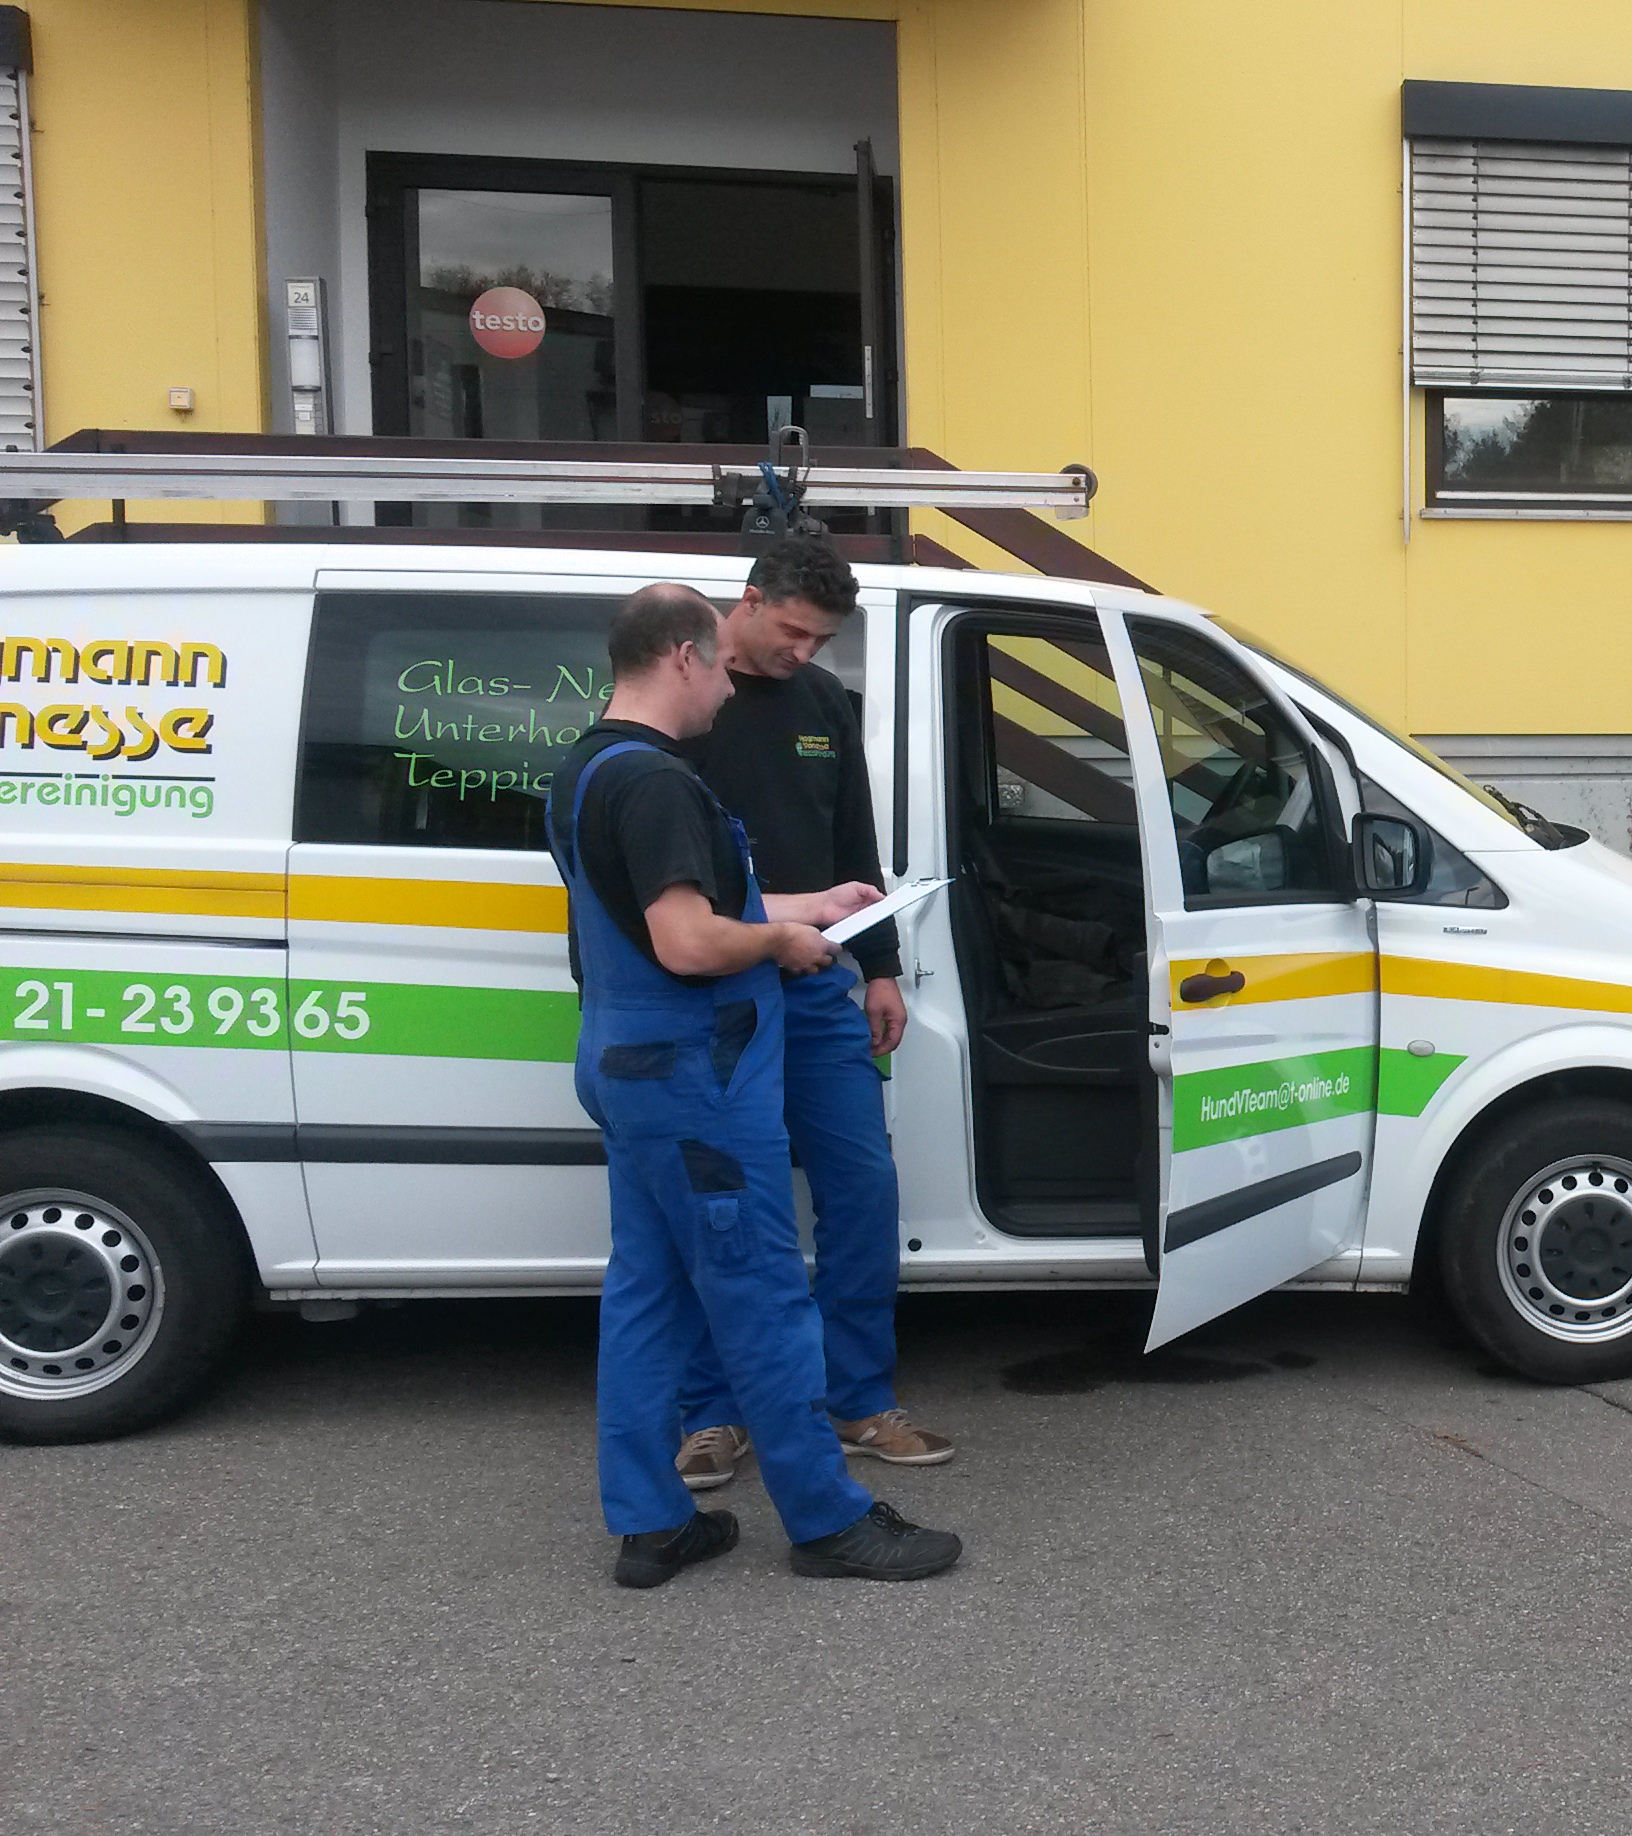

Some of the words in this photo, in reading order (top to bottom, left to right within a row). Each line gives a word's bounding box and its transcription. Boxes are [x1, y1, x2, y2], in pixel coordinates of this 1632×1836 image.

[293, 291, 310, 304] 24
[471, 309, 545, 332] testo
[0, 636, 227, 689] mann
[397, 659, 531, 696] Glas-
[394, 752, 555, 802] Teppic
[1200, 1071, 1350, 1122] HundVTeam@t-online.de
